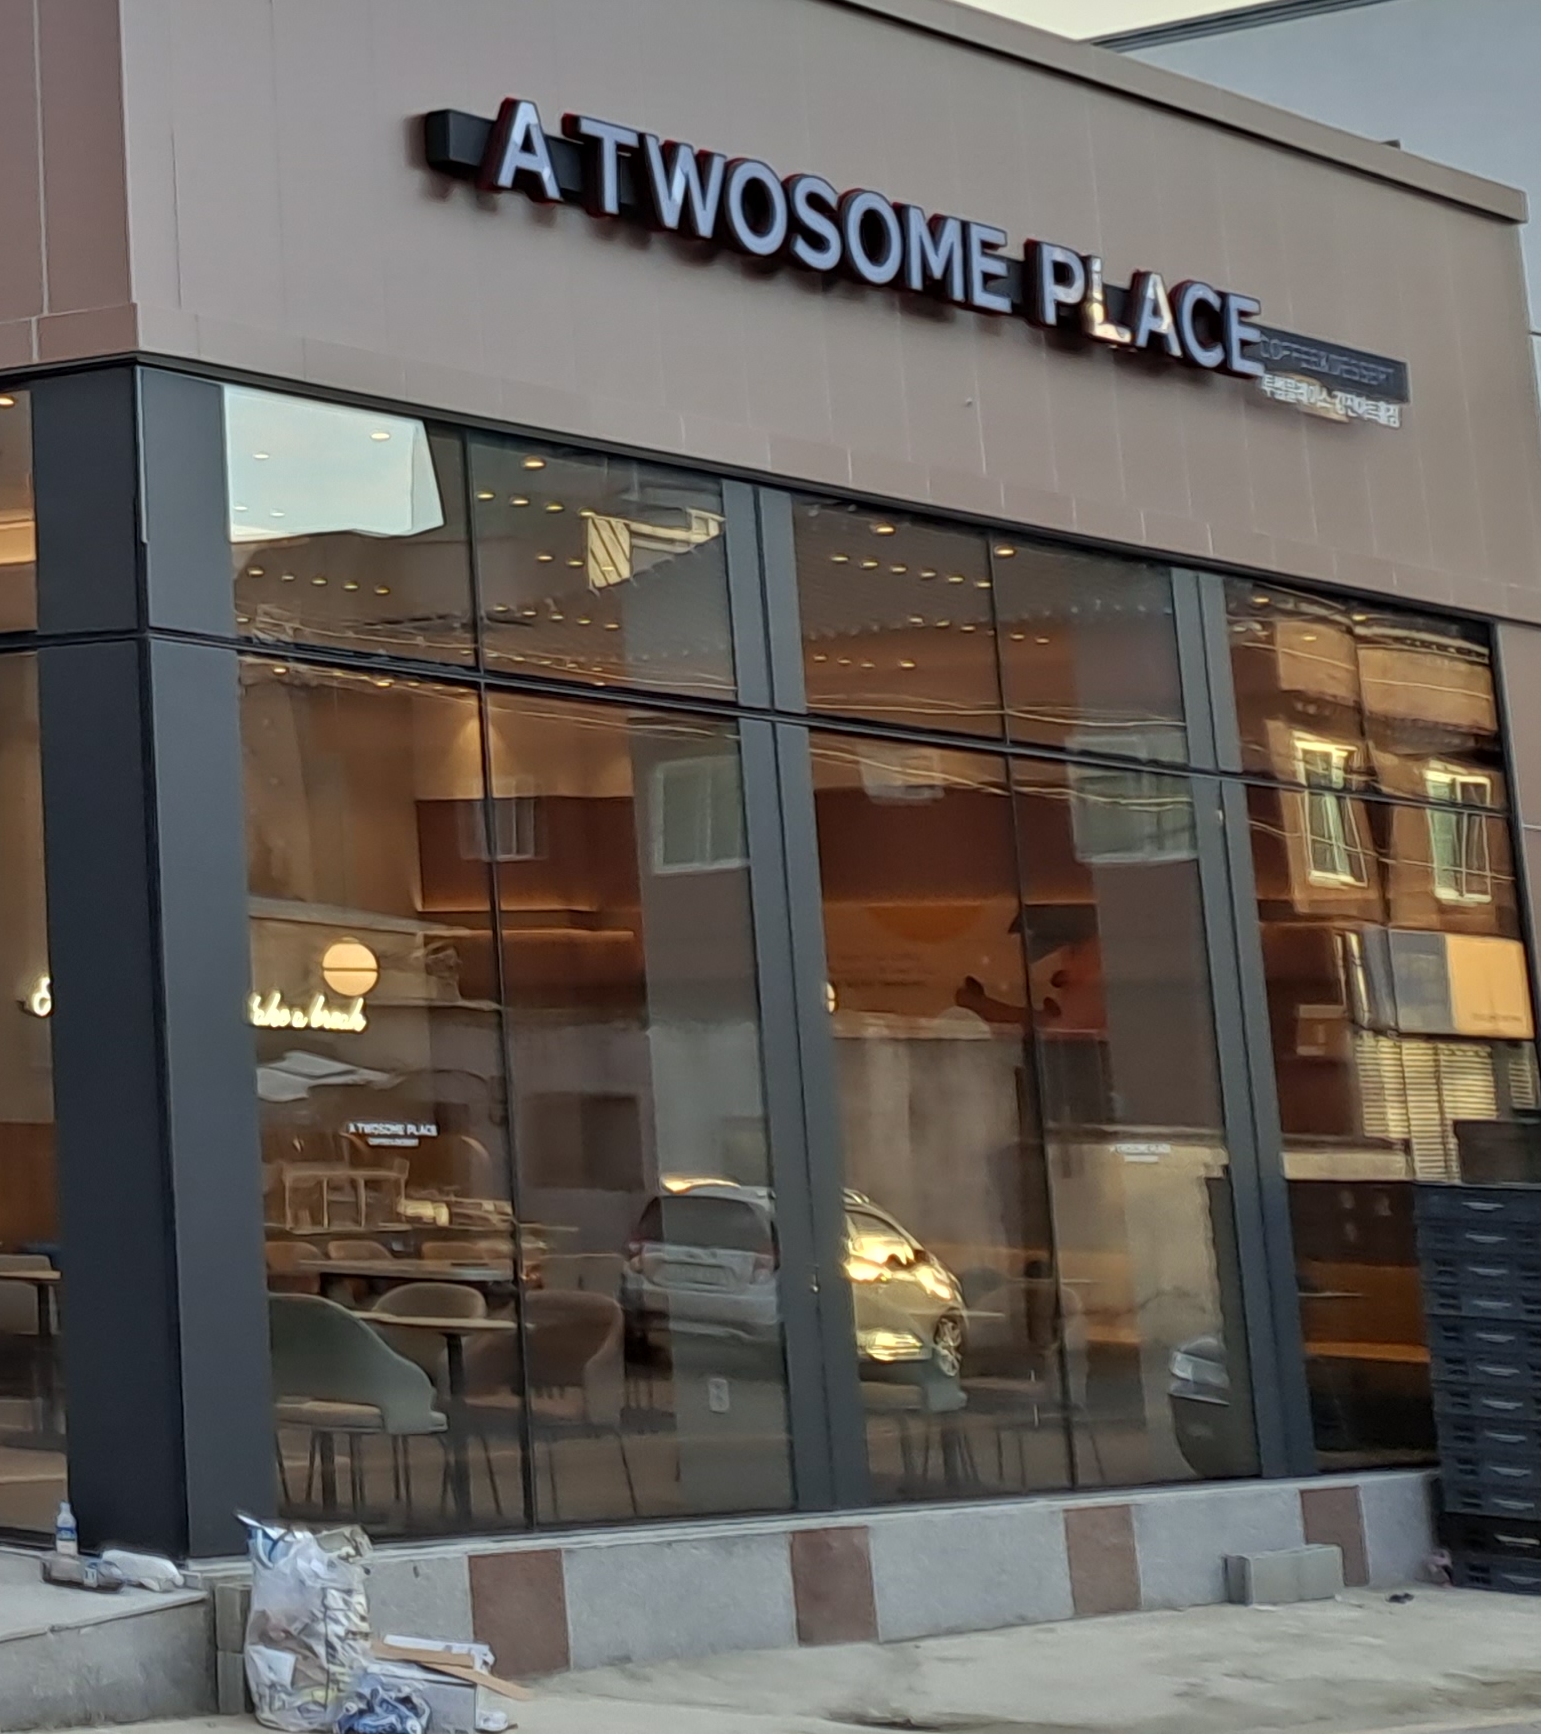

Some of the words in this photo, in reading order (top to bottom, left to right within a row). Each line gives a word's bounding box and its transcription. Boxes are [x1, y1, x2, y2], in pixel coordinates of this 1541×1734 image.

[495, 99, 562, 203] A
[578, 116, 1014, 315] TWOSOME
[1032, 240, 1265, 377] PLACE
